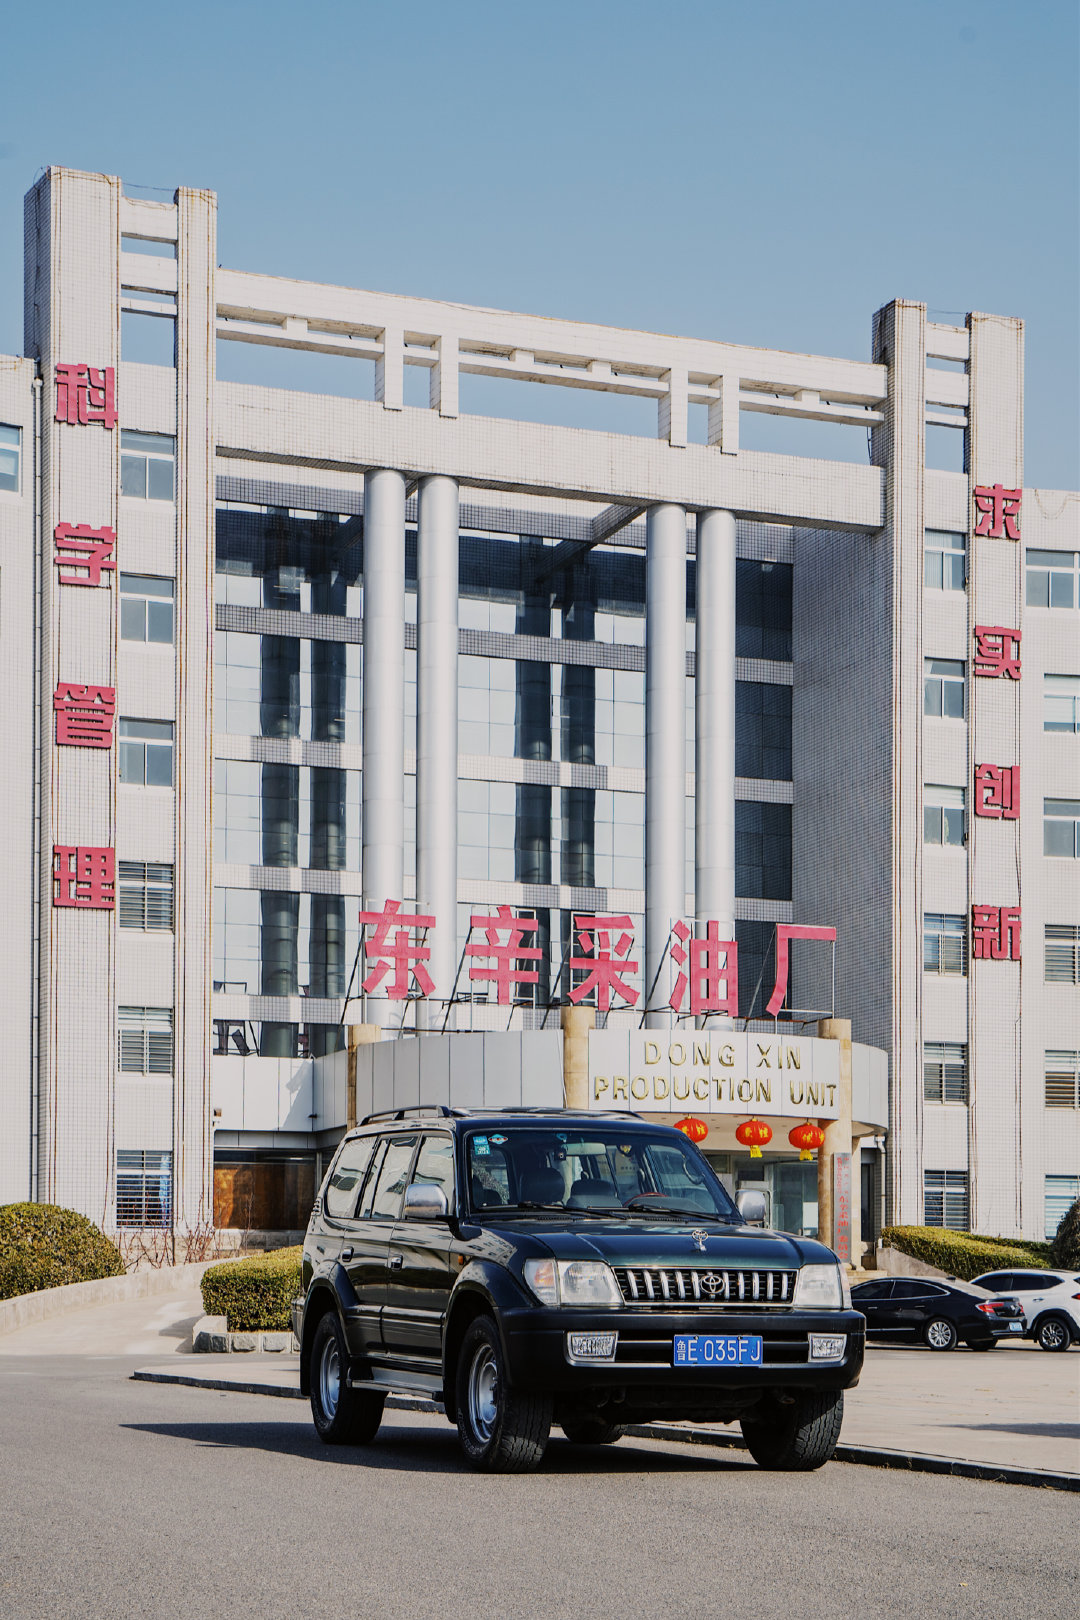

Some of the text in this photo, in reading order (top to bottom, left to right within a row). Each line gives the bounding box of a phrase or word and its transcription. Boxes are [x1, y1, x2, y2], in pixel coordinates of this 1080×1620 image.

[52, 363, 118, 910] 科学管理
[973, 484, 1022, 961] 求实创新
[359, 899, 837, 1017] 东辛采油厂
[593, 1075, 837, 1107] PRODUCTION UNIT
[644, 1041, 801, 1070] DONG XIN
